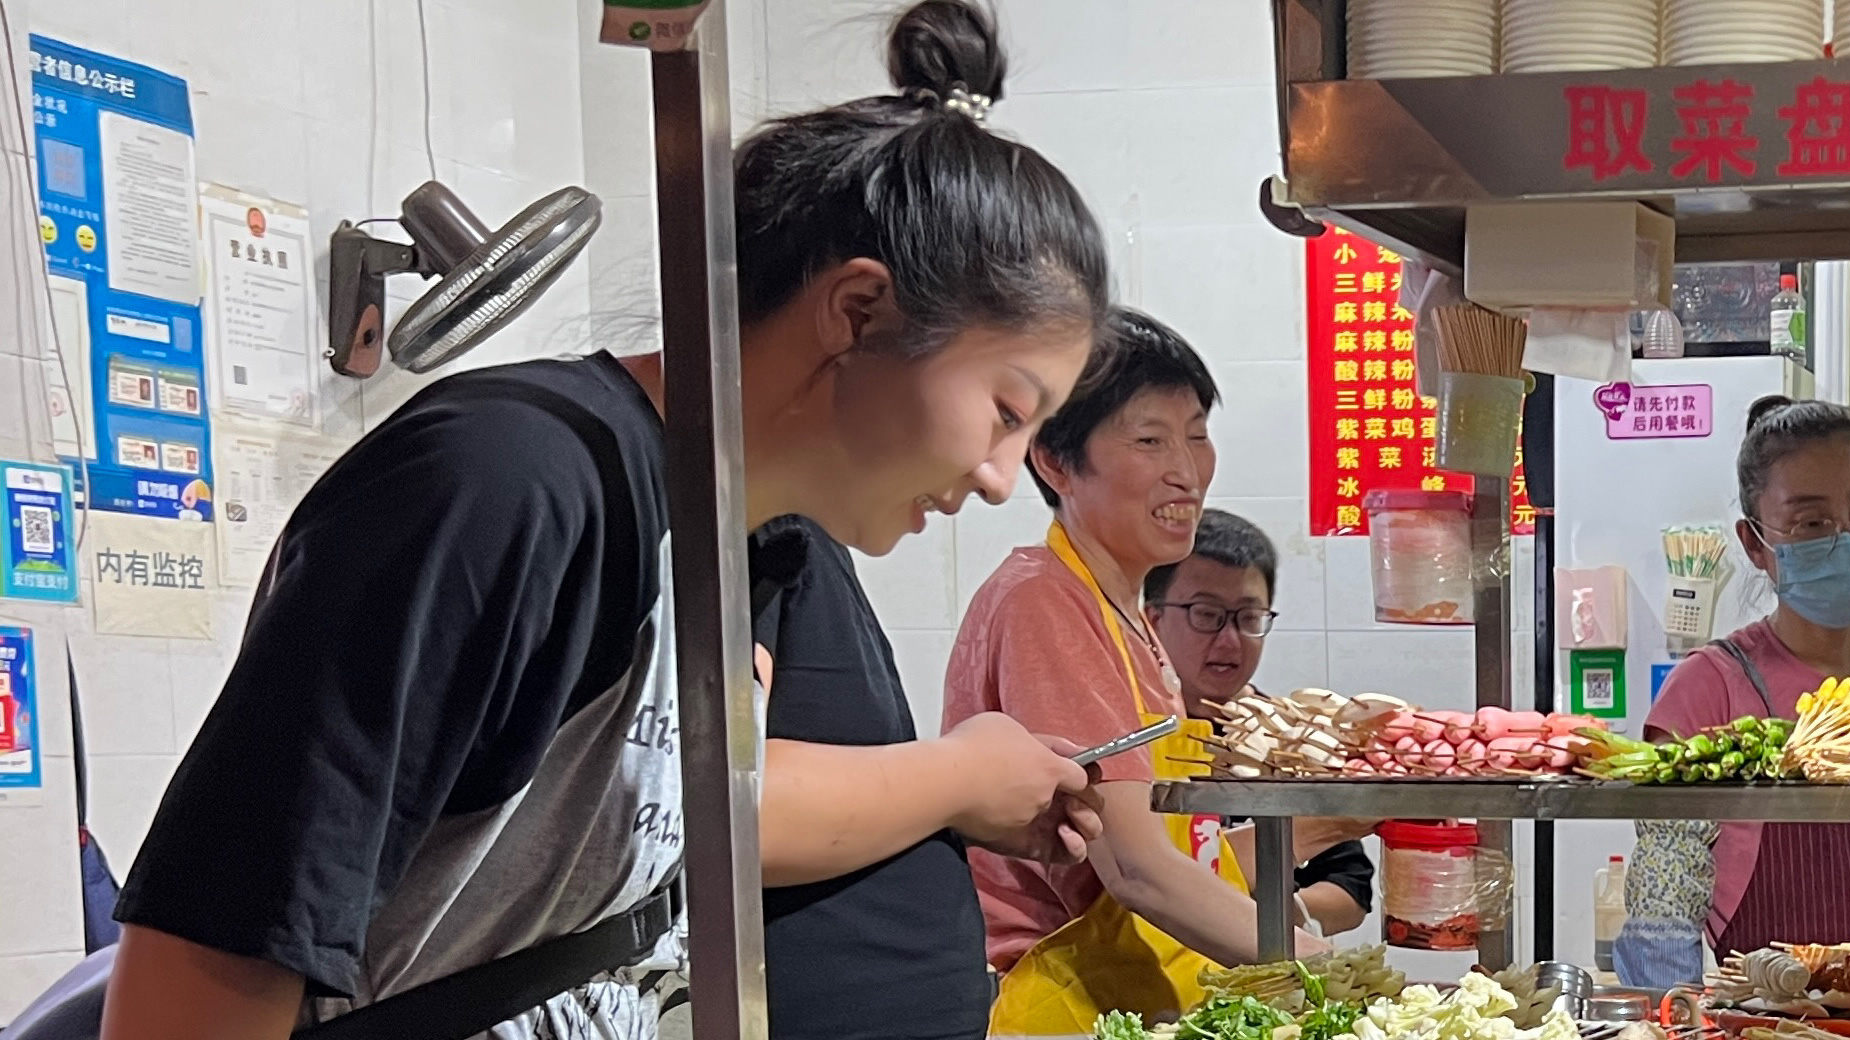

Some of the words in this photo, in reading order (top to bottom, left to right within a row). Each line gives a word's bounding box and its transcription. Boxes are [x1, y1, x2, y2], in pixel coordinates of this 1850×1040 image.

[1334, 330, 1415, 352] 麻辣粉
[1334, 359, 1415, 381] 酸辣粉
[1633, 395, 1696, 412] 请先付款
[1513, 505, 1537, 525] 元
[96, 547, 206, 590] 内有监控
